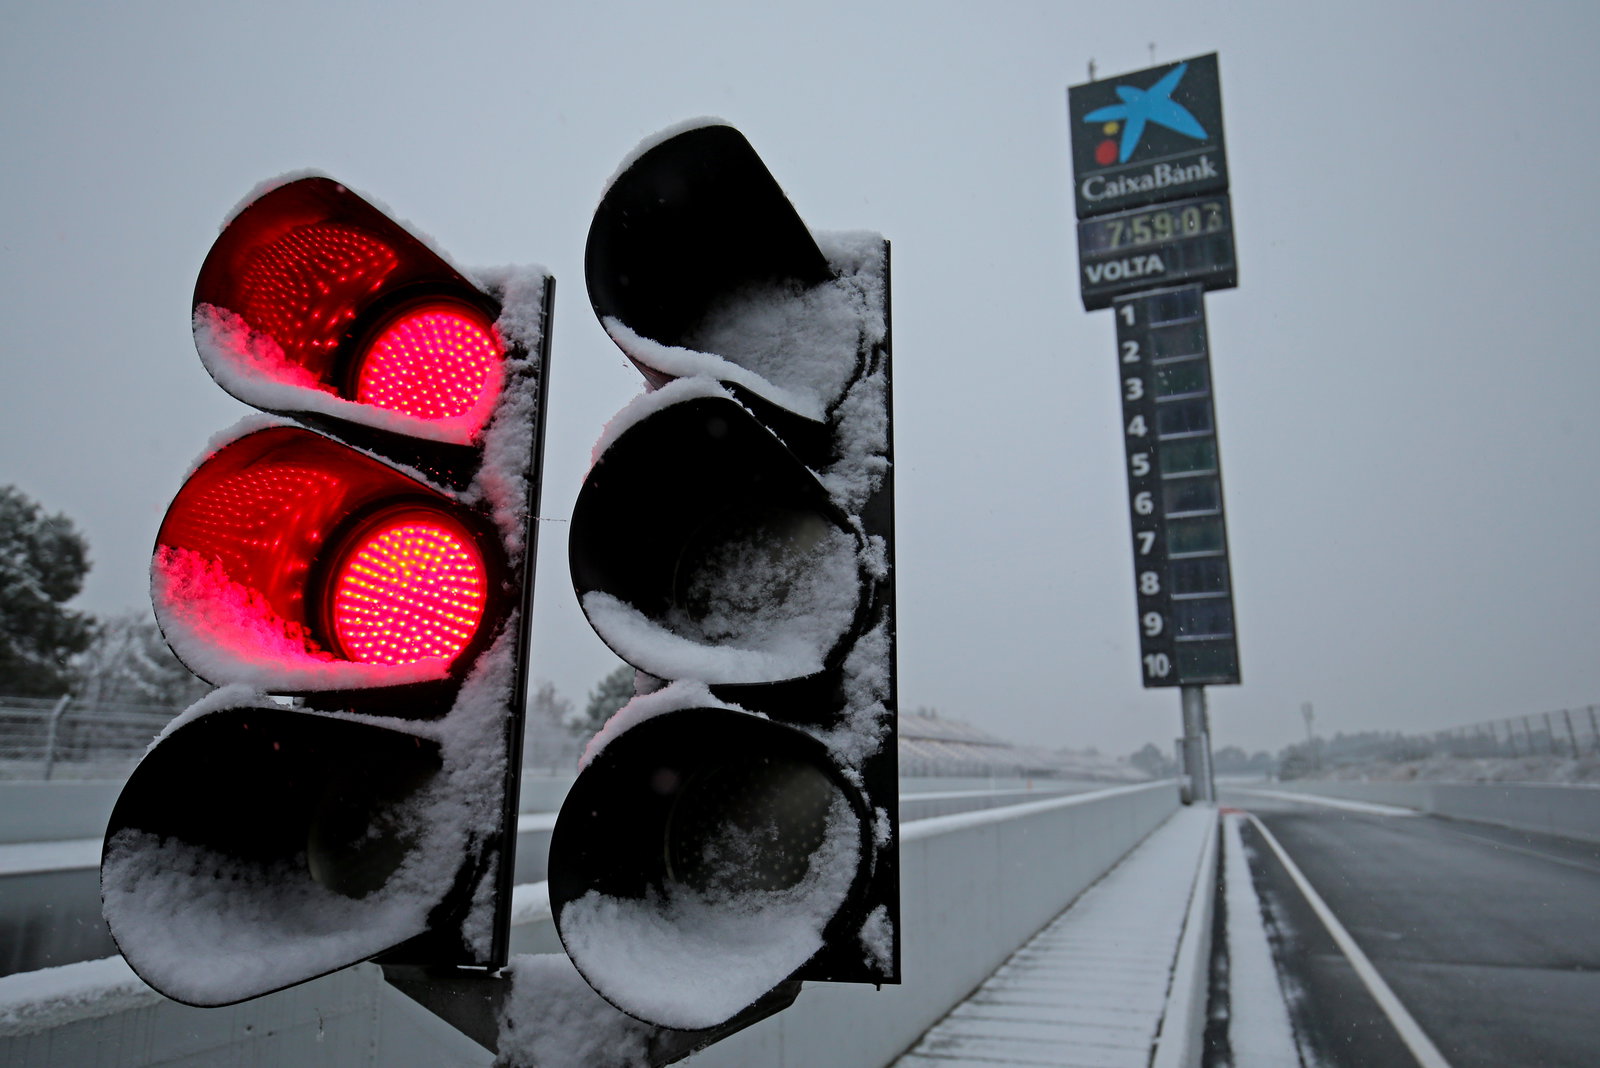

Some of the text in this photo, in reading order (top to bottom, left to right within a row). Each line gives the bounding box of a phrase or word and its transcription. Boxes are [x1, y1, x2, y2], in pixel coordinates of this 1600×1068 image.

[1082, 156, 1217, 202] CaixaBank
[1086, 253, 1164, 283] VOLTA
[1120, 305, 1135, 325] 1
[1123, 341, 1140, 363] 2
[1125, 377, 1144, 400] 3
[1127, 415, 1147, 437] 4
[1132, 453, 1150, 477] 5
[1134, 492, 1154, 514] 6
[1137, 531, 1155, 555] 7
[1140, 571, 1160, 595] 8
[1143, 612, 1163, 636] 9
[1144, 653, 1170, 677] 10
